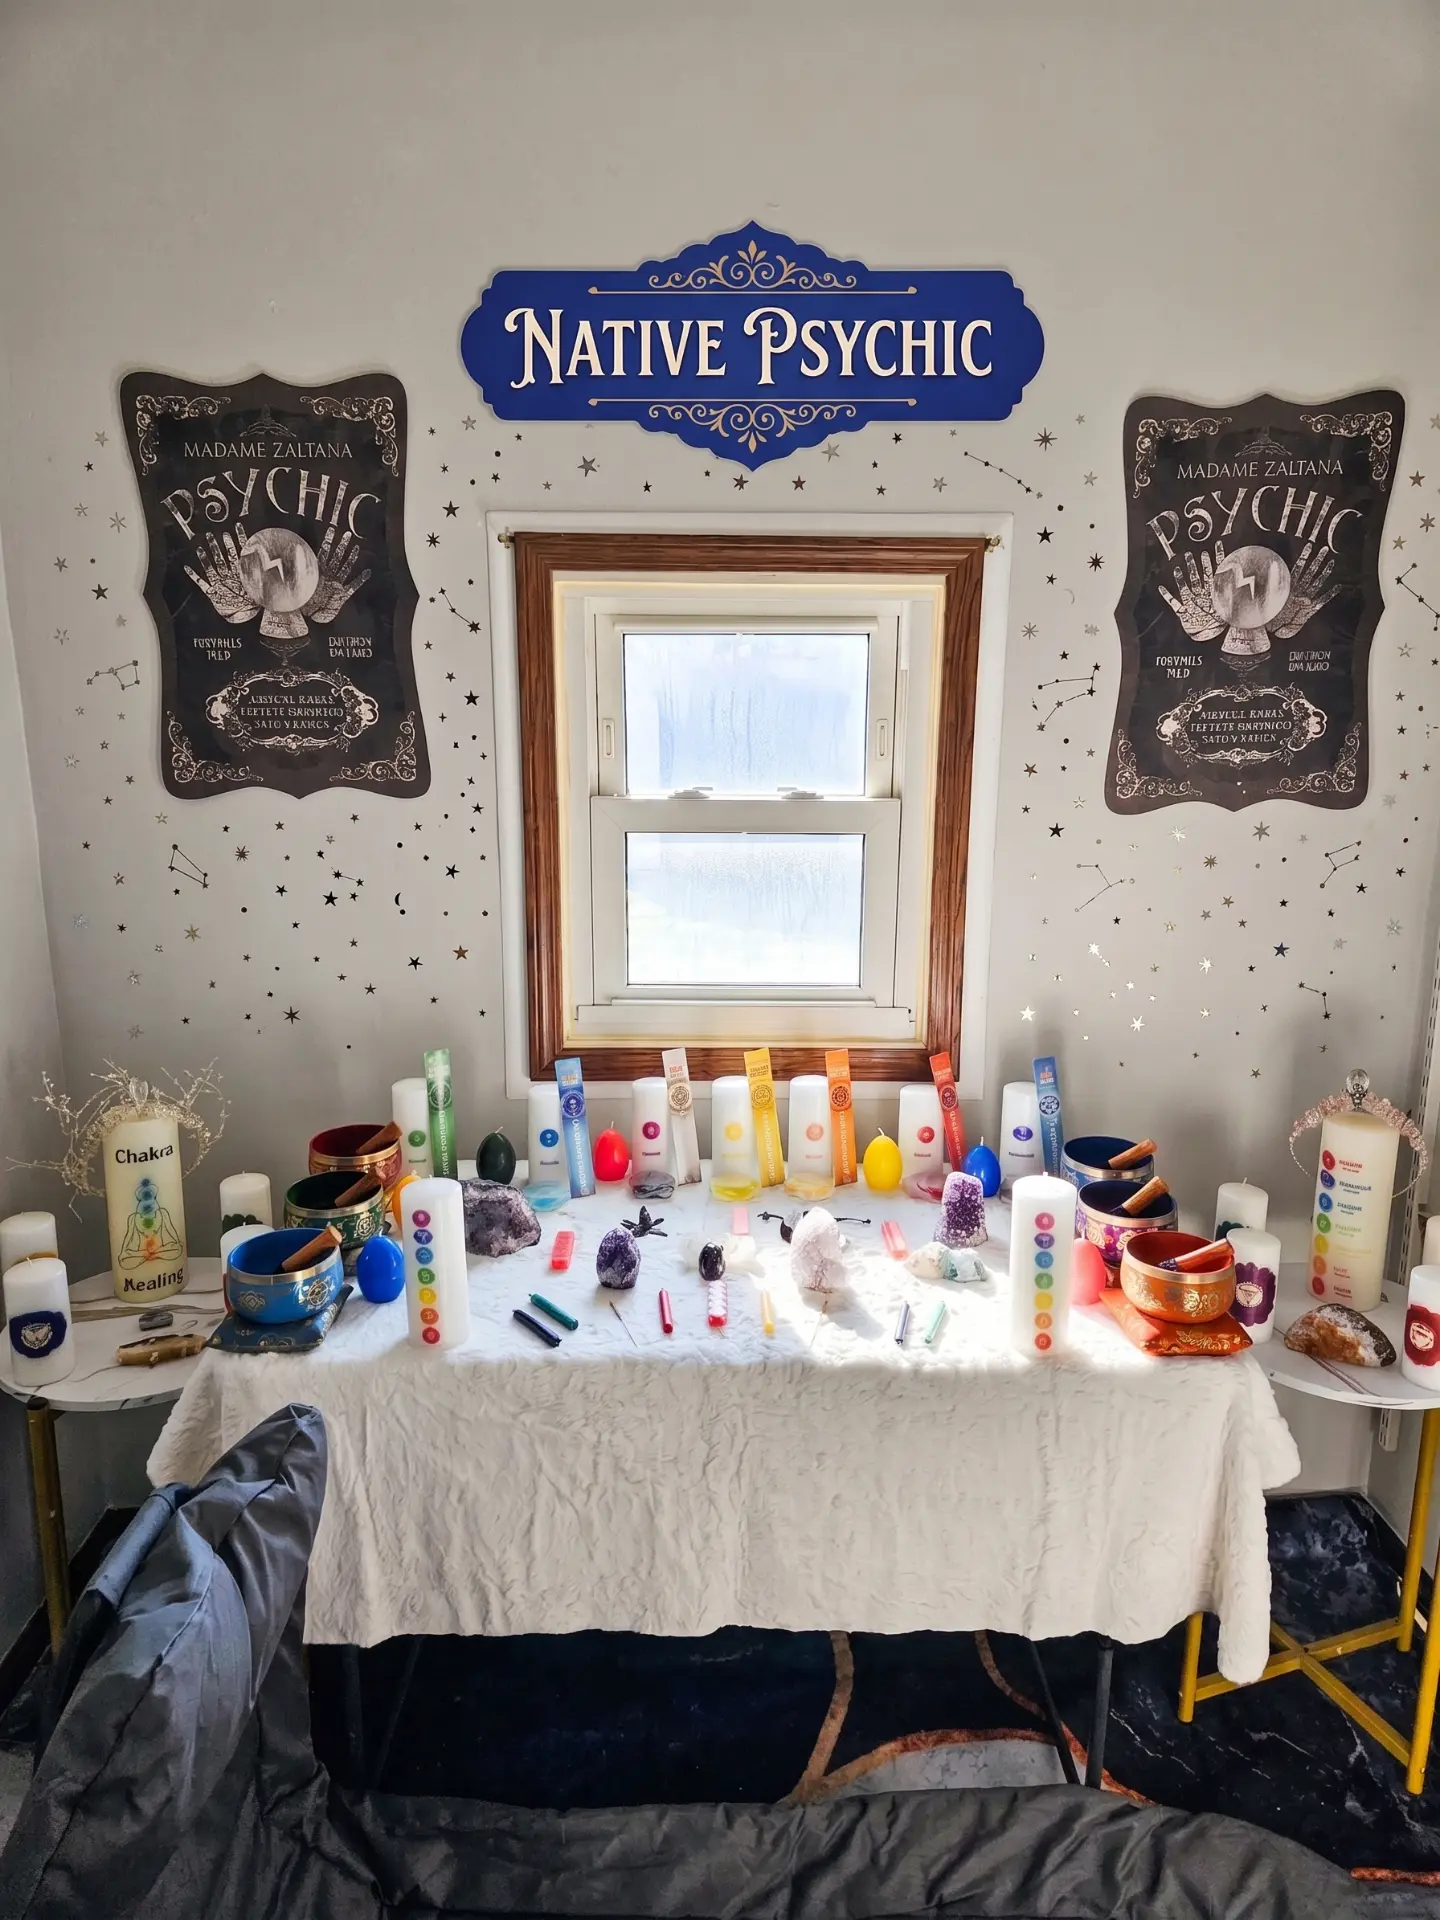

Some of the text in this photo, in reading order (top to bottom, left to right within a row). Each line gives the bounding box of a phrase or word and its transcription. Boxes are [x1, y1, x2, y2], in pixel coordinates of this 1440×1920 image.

[504, 307, 994, 389] NATIVE PSYCHIC
[184, 442, 353, 459] MADAME ZALTANA
[1177, 460, 1344, 479] MADAME ZALTANA
[160, 466, 381, 540] PSYCHIC
[1146, 485, 1363, 561] PSYCHIC
[115, 1144, 174, 1165] Chakra
